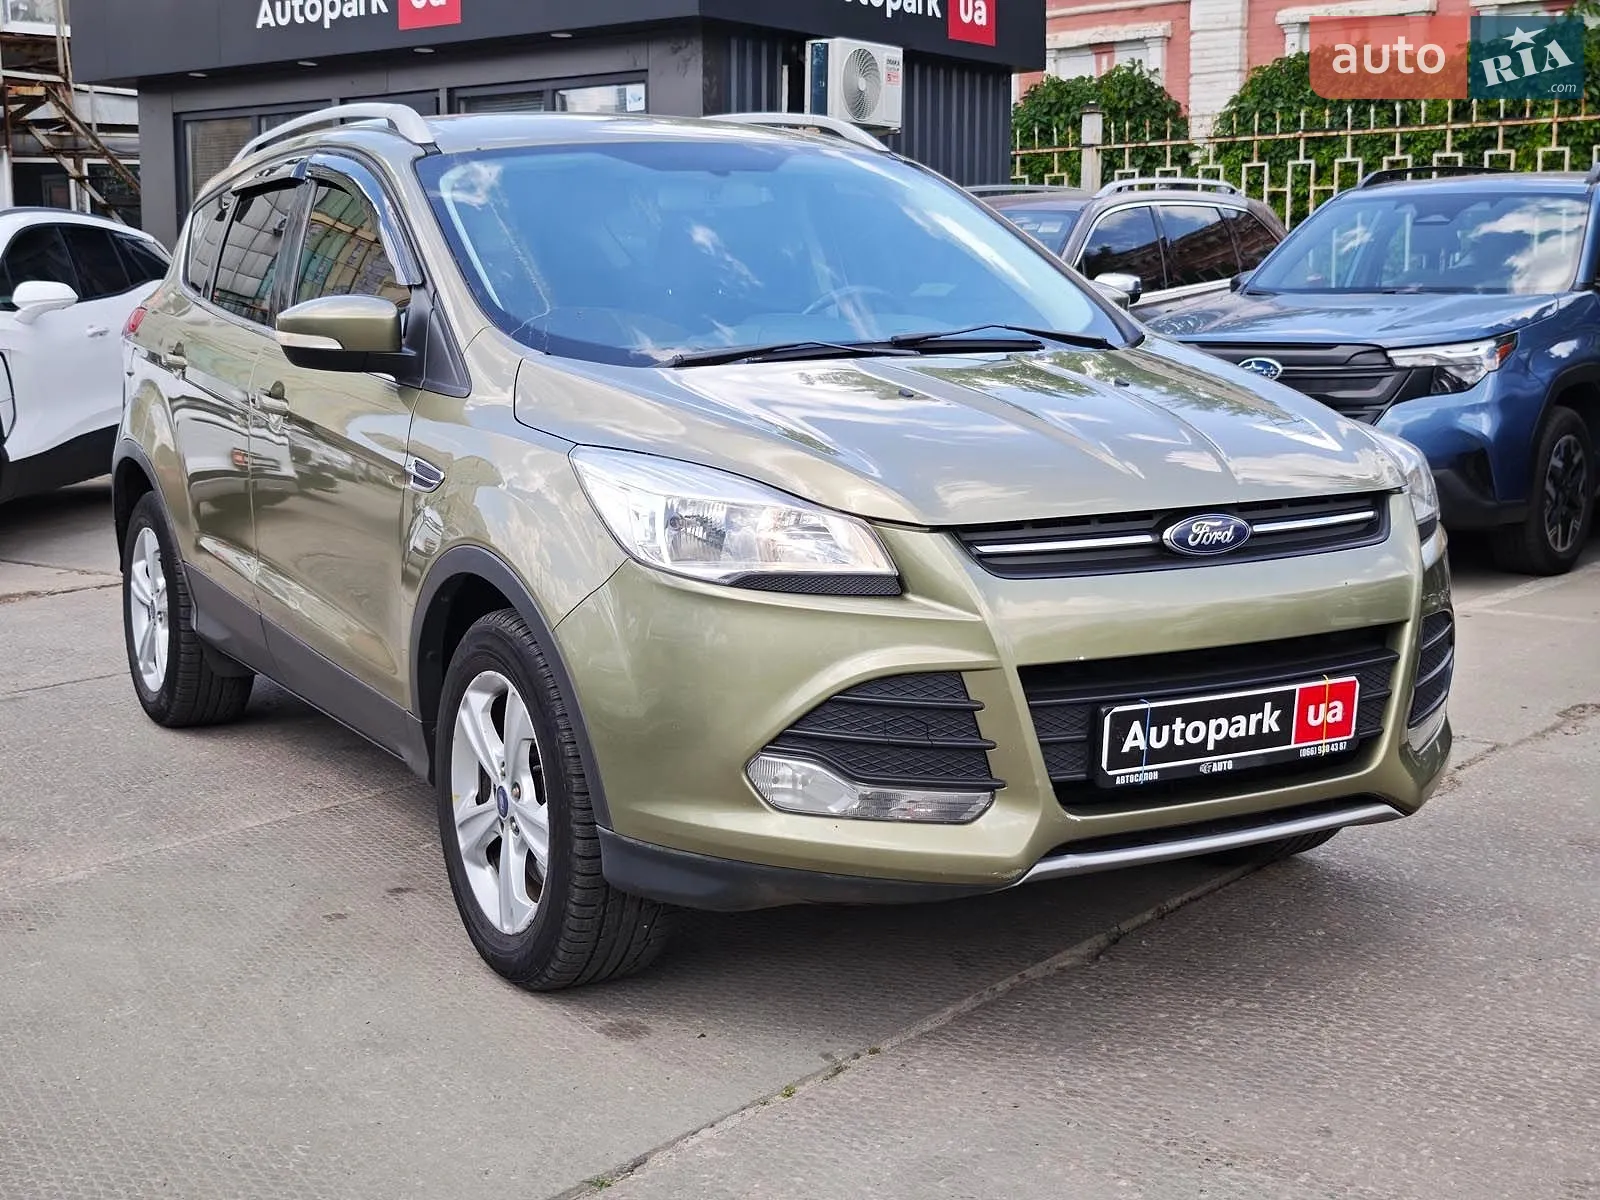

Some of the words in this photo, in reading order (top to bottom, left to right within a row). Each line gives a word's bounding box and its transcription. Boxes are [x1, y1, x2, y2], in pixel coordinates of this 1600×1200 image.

[1188, 520, 1235, 547] Ford
[1121, 701, 1282, 753] Autopark
[1307, 699, 1343, 727] ua
